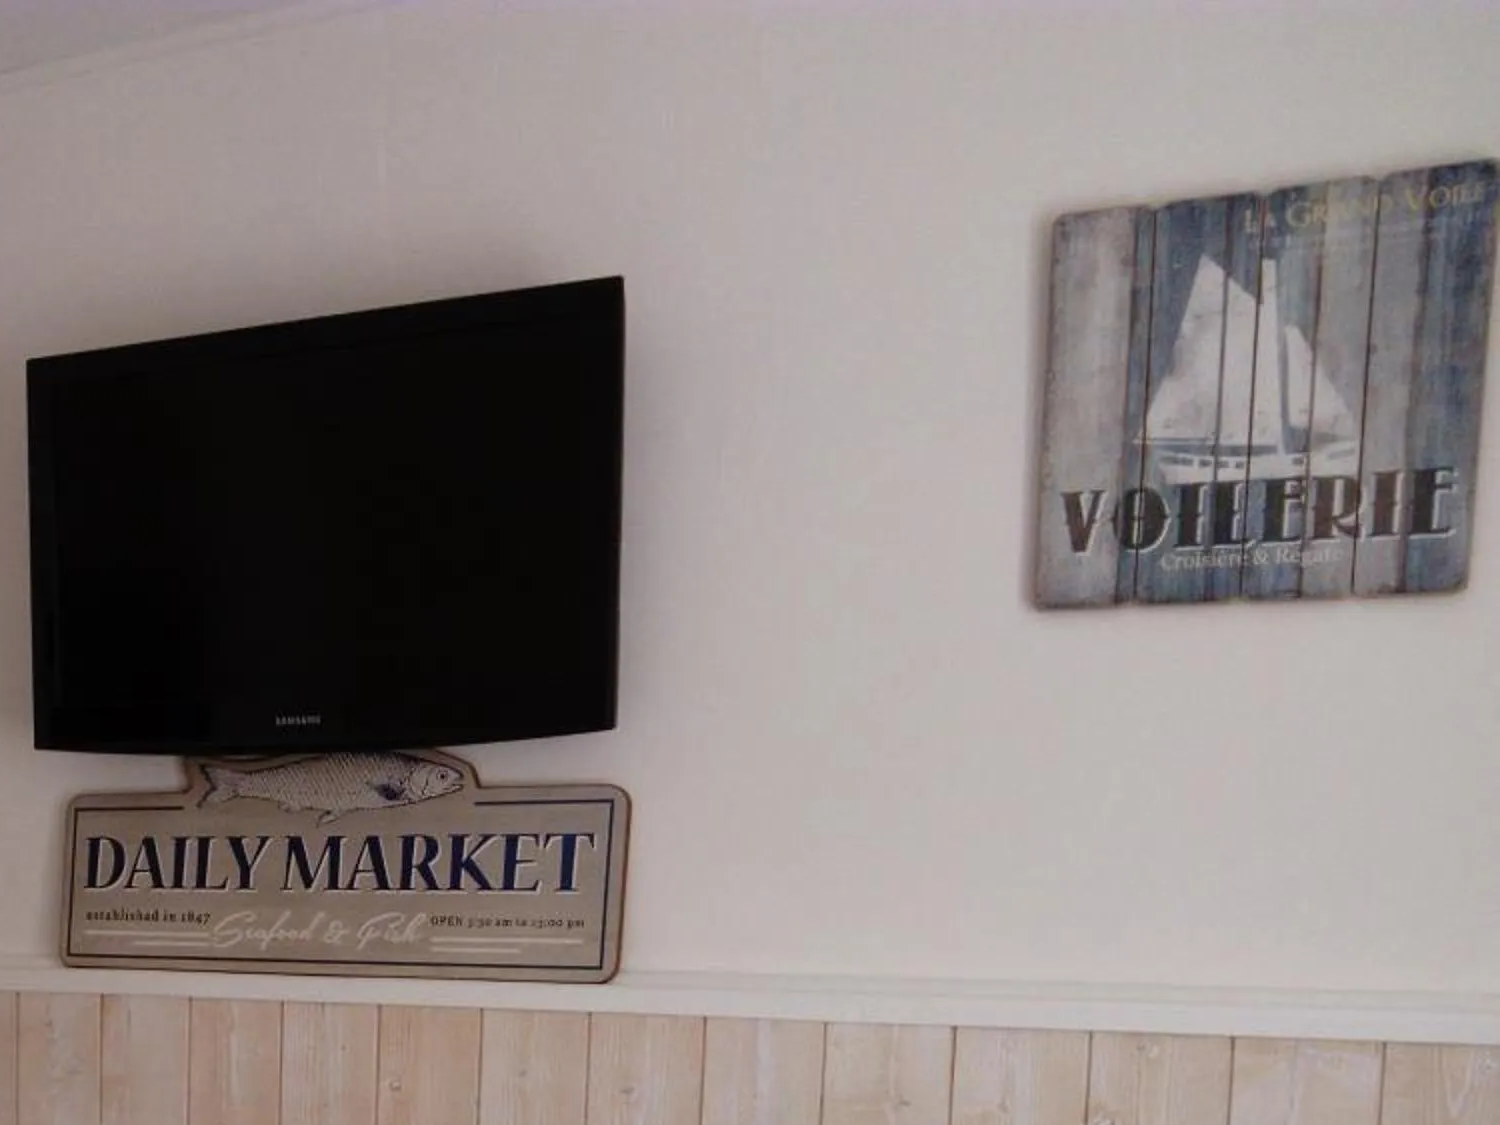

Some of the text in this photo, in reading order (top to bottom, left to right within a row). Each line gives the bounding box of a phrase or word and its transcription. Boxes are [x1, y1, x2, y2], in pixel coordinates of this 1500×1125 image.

[1060, 465, 1460, 557] VOILERIE
[84, 831, 597, 896] DAILY MARKET
[86, 907, 159, 922] established
[162, 909, 177, 922] in
[323, 919, 349, 945] &
